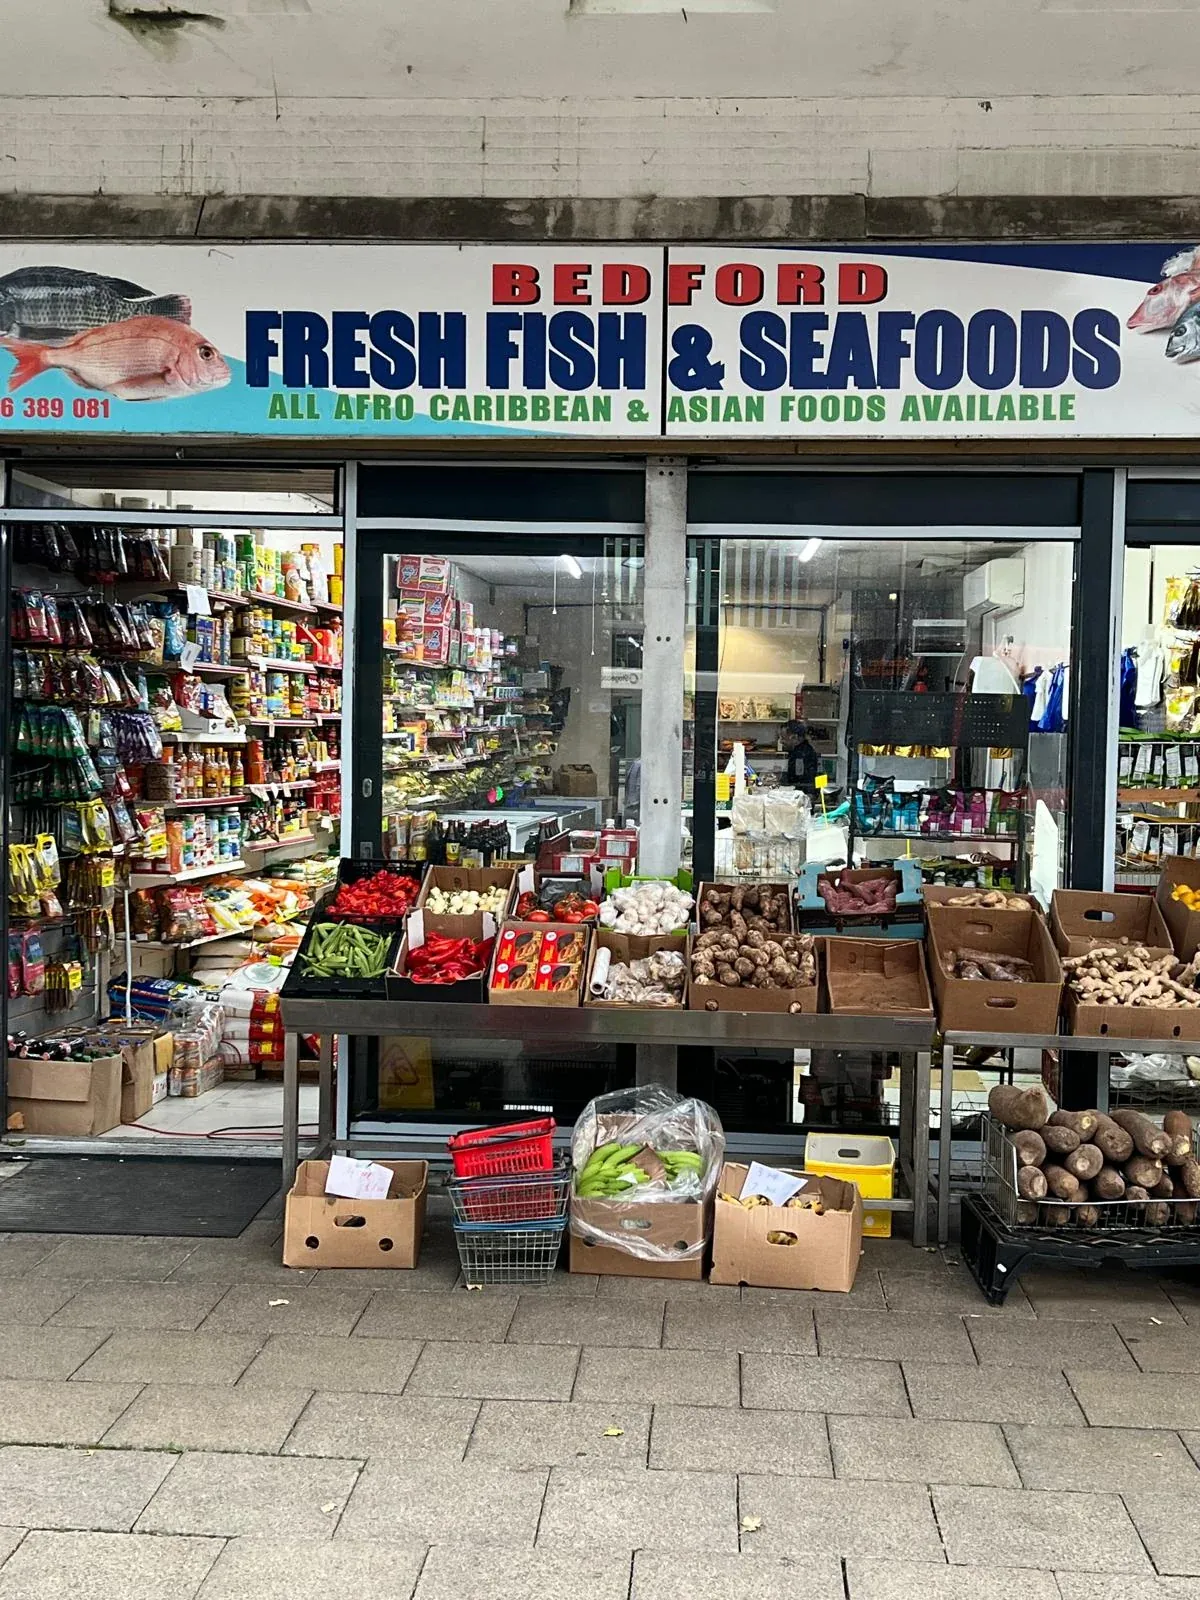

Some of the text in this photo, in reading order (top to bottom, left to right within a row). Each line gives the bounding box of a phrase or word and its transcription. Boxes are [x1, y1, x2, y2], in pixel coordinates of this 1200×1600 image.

[492, 263, 889, 307] BEDFORD
[245, 307, 1121, 391] FRESH FISH & SEAFOODS
[23, 397, 64, 418] 389
[72, 398, 110, 419] 081
[268, 393, 1076, 423] ALL AFRO CARIBBEAN & ASIAN FOODS AVAILABLE
